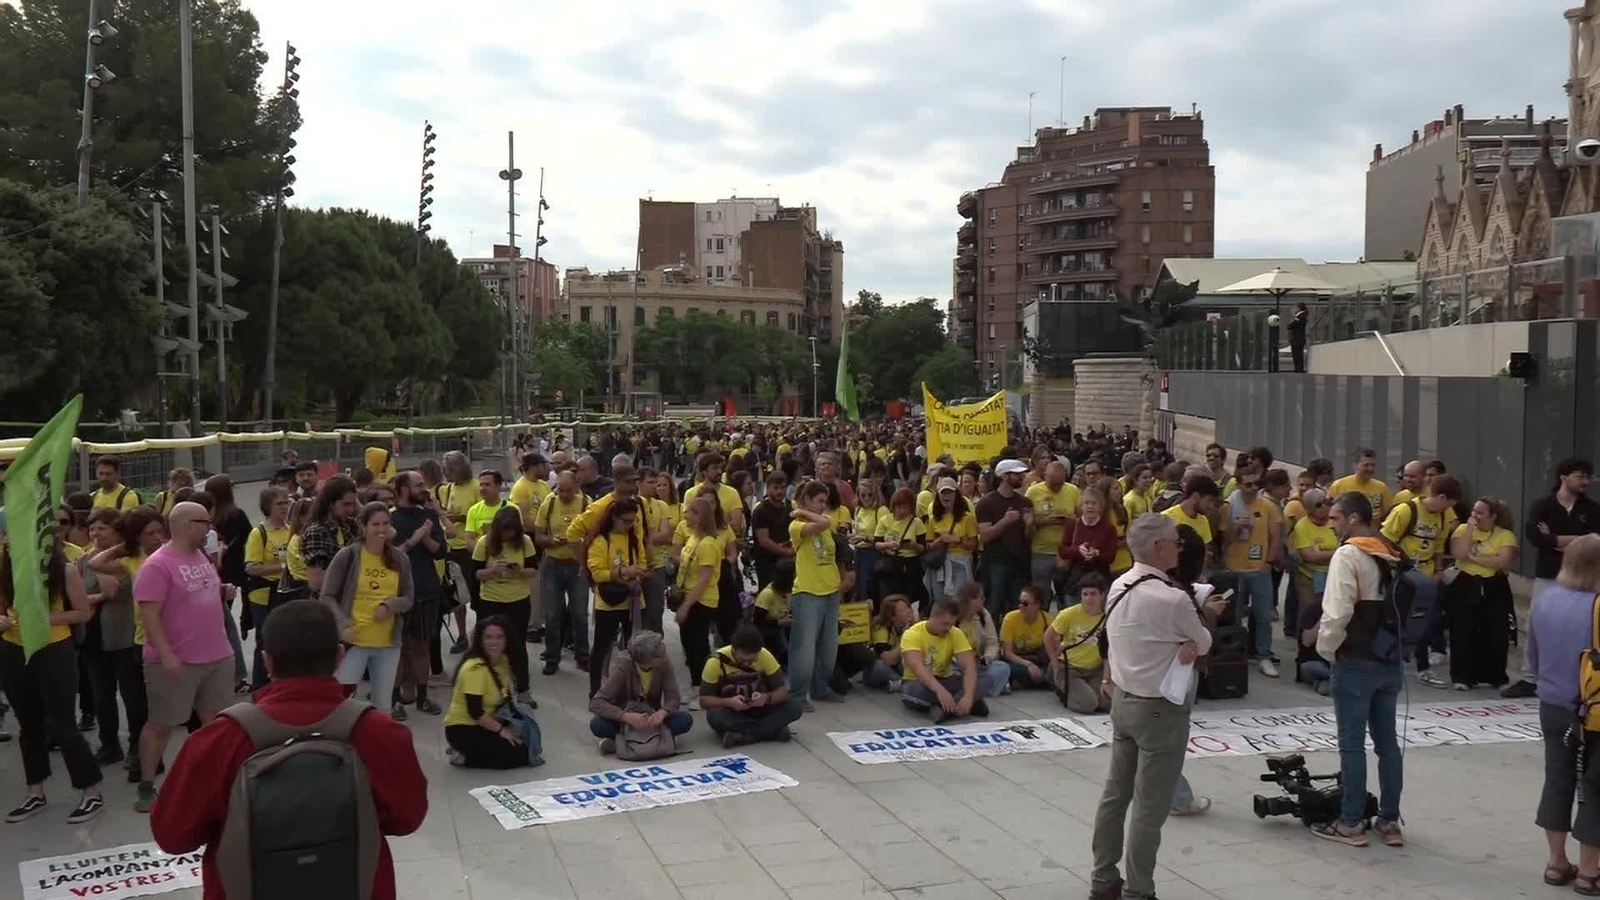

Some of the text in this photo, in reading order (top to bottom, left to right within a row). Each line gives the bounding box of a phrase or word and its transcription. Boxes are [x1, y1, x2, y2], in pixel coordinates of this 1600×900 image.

[364, 568, 387, 578] SOS
[850, 732, 1014, 754] EDUCATIVA
[874, 727, 955, 740] VAGA
[579, 766, 673, 785] VAGA
[551, 770, 739, 806] EDUCATIVA
[50, 850, 151, 872] LLUITEM
[70, 871, 175, 897] VOSTRES
